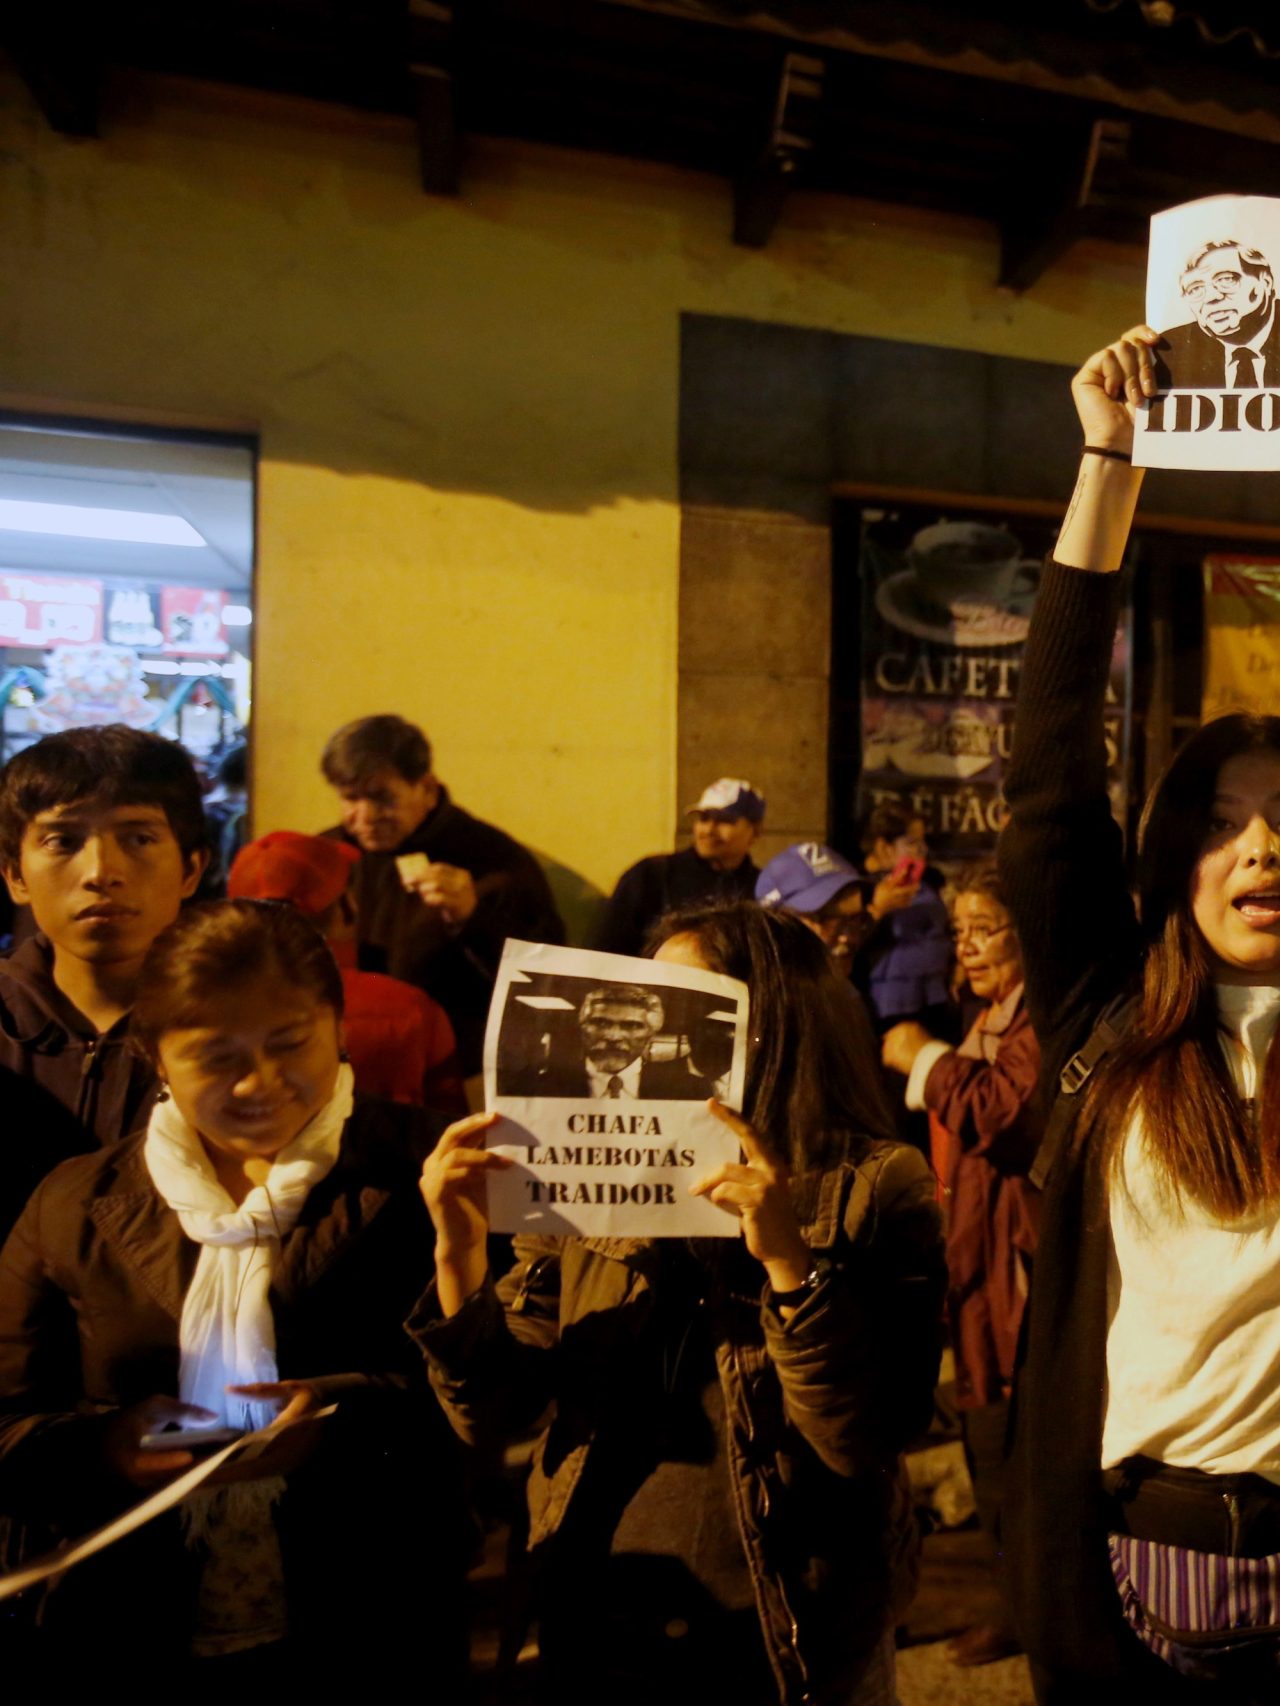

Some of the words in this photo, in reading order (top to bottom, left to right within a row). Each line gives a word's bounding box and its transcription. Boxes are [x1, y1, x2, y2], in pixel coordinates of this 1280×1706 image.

[567, 1113, 662, 1136] CHAFA
[526, 1146, 696, 1168] LAMEBOTAS
[525, 1180, 677, 1205] TRAIDOR
